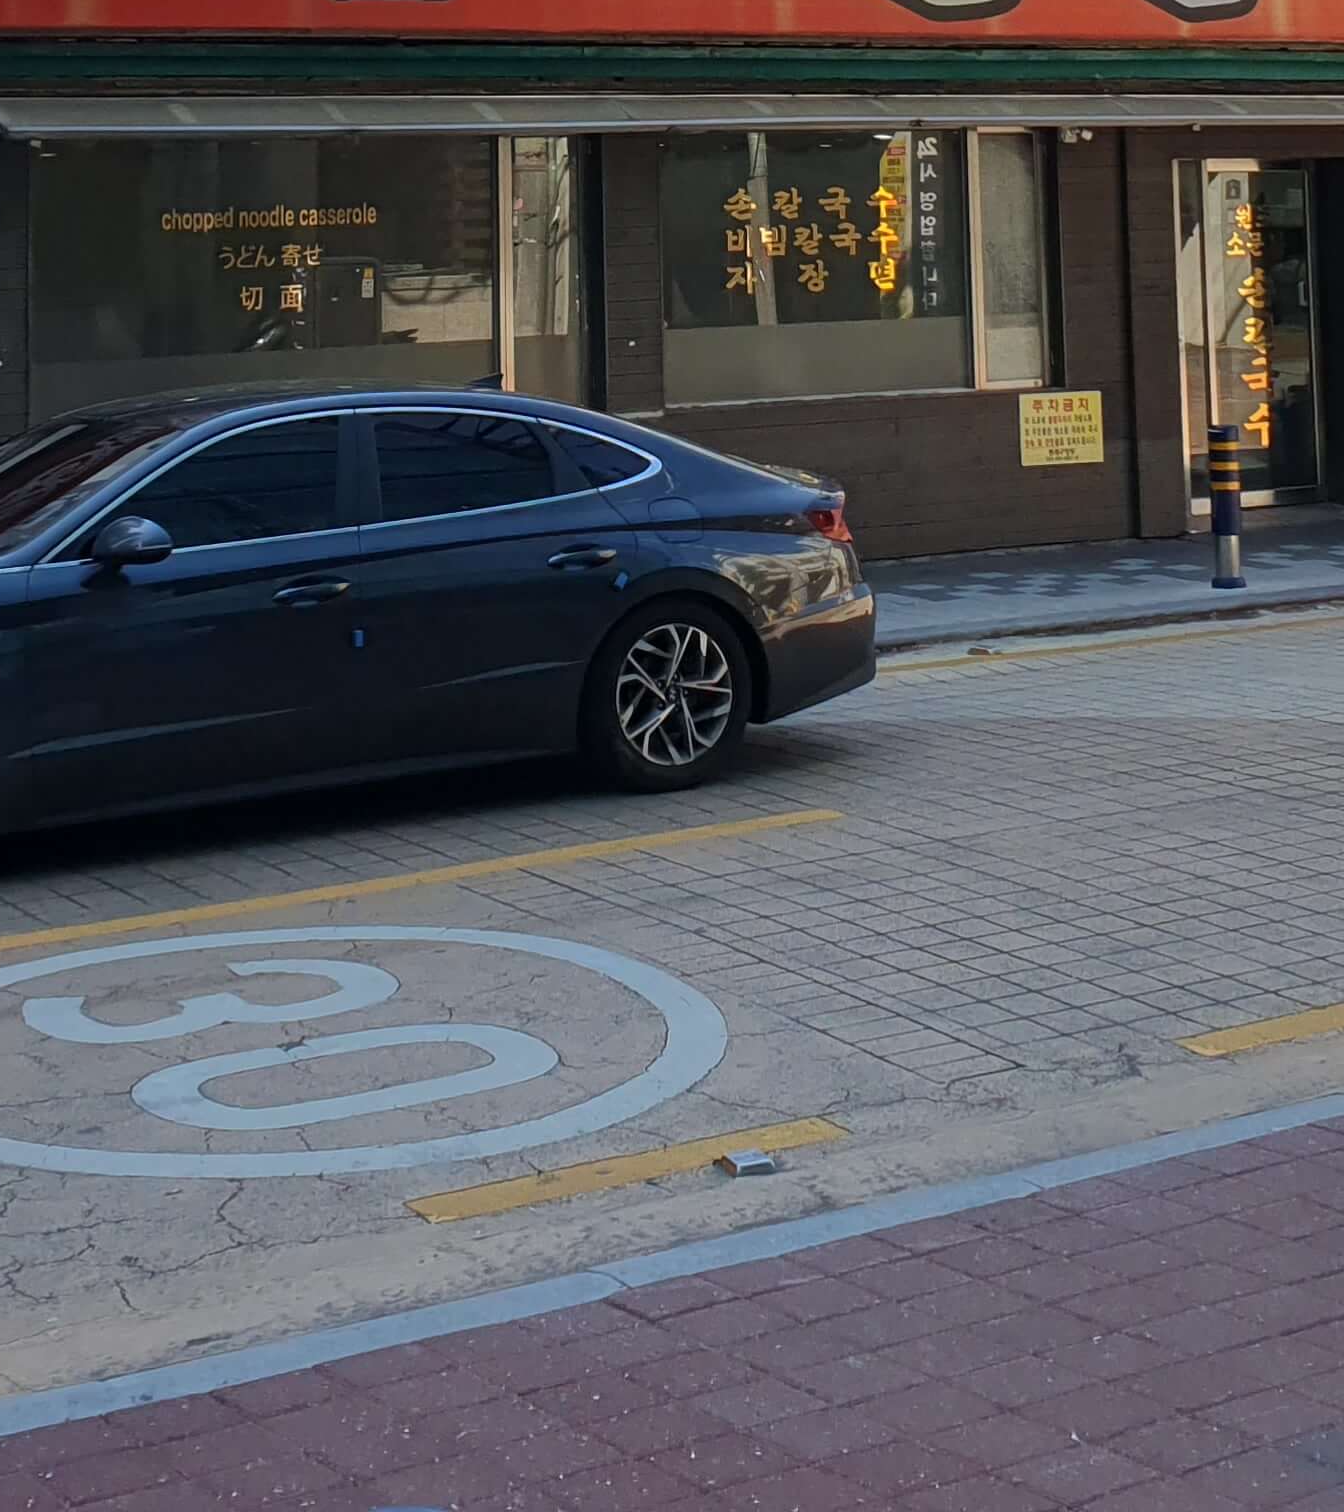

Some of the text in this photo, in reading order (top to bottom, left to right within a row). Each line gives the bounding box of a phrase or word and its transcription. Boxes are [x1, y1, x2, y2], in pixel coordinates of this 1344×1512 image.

[161, 201, 377, 232] chopped noodle casserole
[724, 186, 898, 221] 손칼국수
[725, 222, 899, 259] 비빔칼국수
[725, 258, 896, 295] 자장면
[23, 959, 561, 1131] 30
